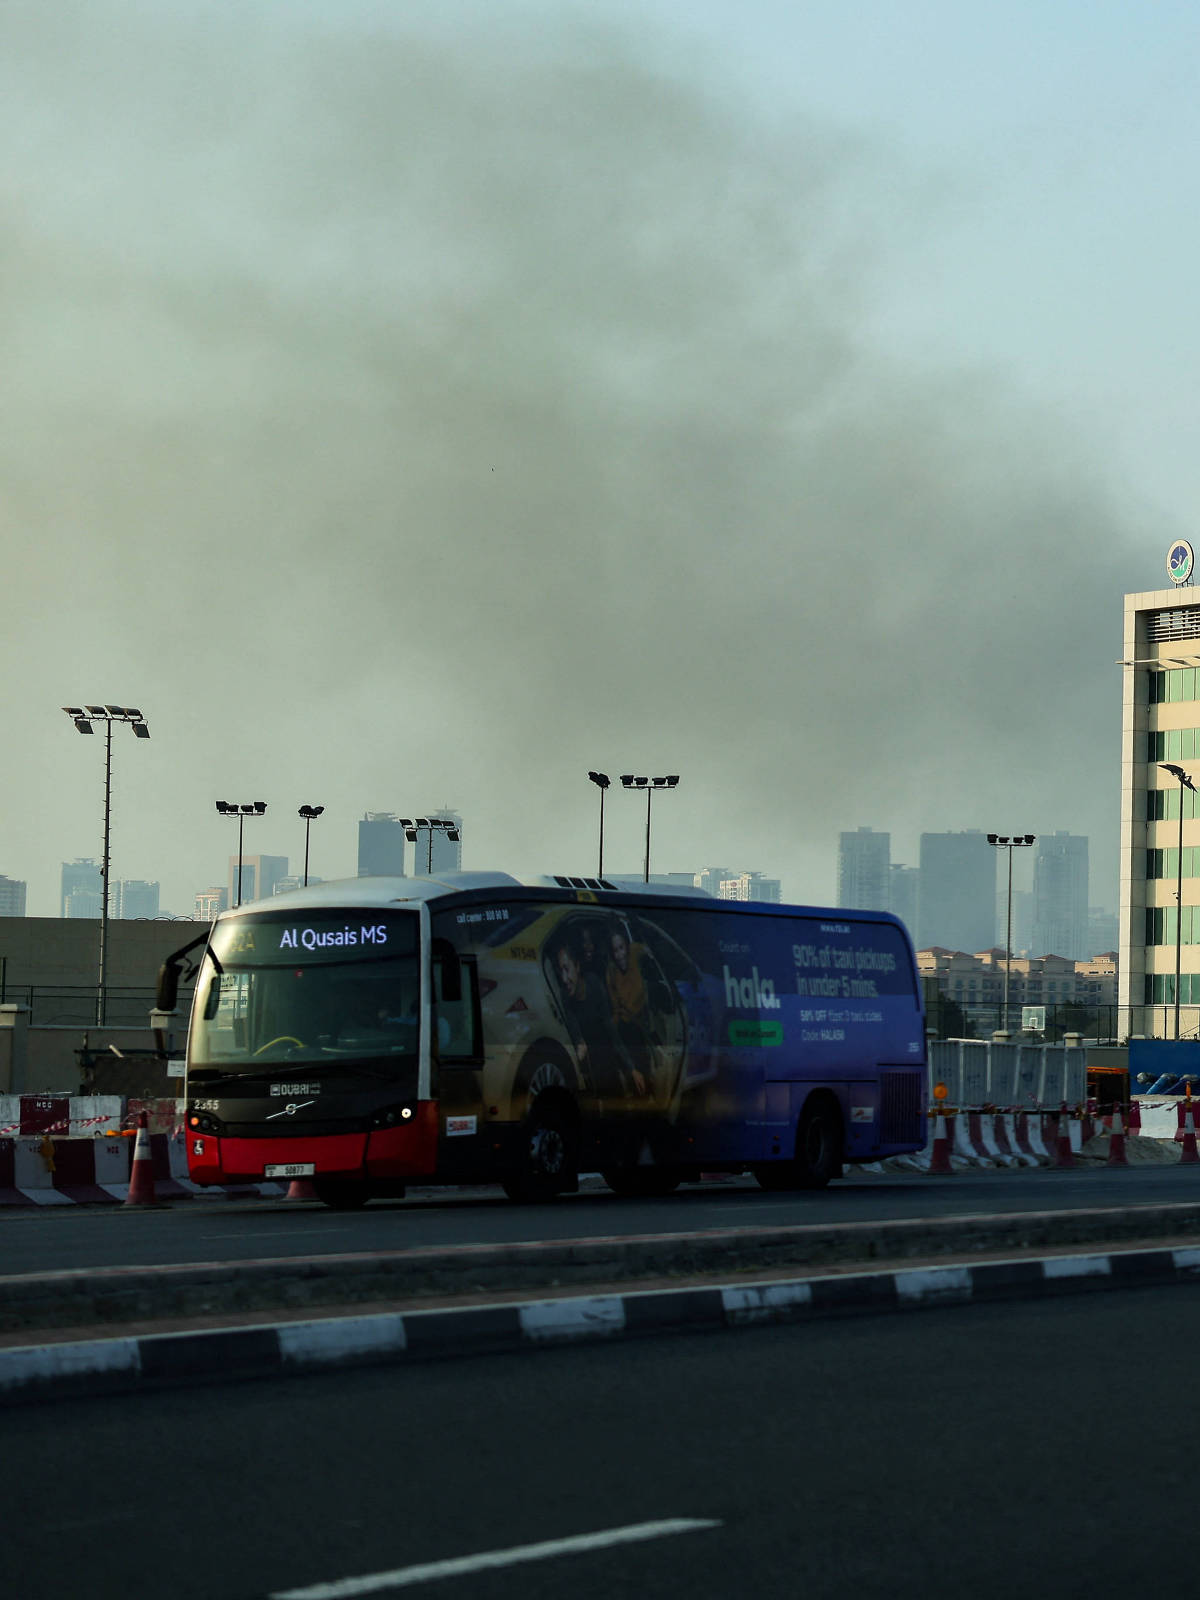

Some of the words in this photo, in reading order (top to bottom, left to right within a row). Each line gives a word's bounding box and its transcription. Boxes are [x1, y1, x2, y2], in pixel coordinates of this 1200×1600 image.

[279, 928, 299, 949] Al
[302, 925, 357, 951] Qusais
[361, 925, 388, 946] MS
[792, 944, 818, 969] 90%
[818, 945, 832, 969] of
[832, 946, 855, 970] taxi
[855, 947, 897, 976] pickups
[723, 964, 781, 1009] hala.
[796, 972, 807, 997] in
[808, 973, 841, 998] under
[842, 975, 850, 998] 5
[281, 1084, 310, 1096] DUBAI
